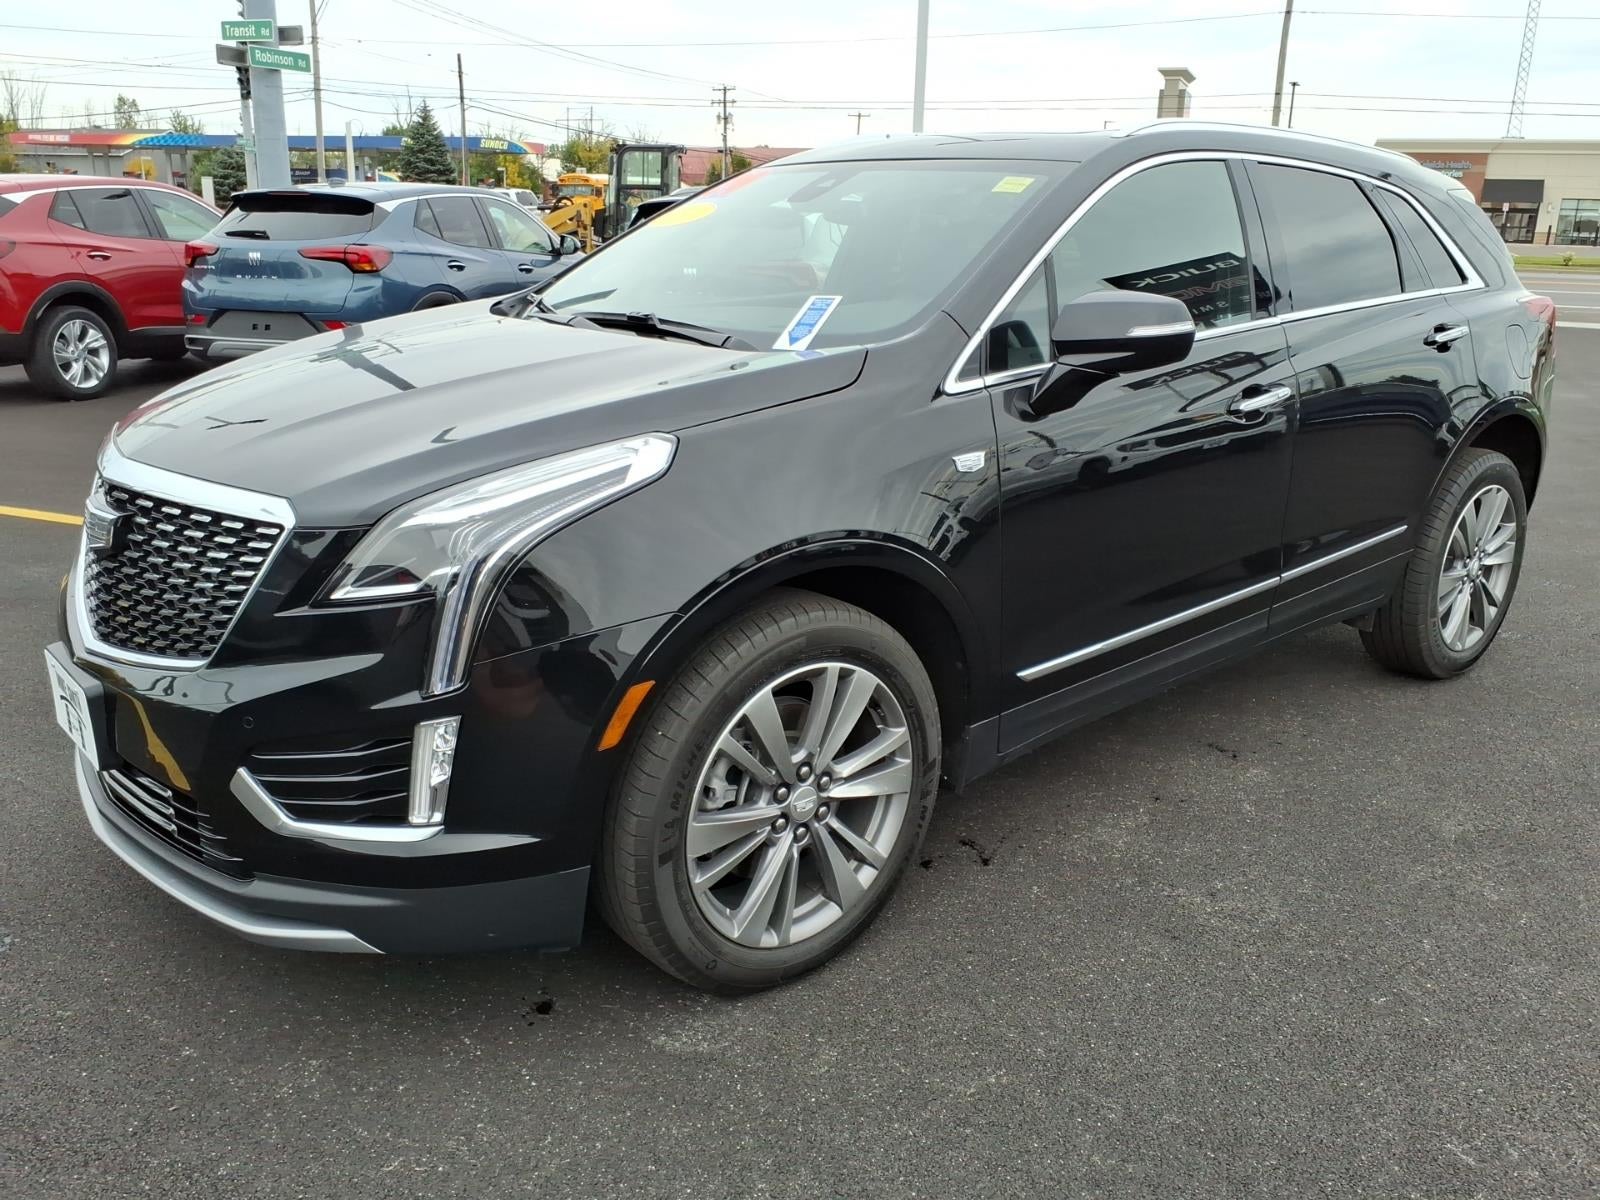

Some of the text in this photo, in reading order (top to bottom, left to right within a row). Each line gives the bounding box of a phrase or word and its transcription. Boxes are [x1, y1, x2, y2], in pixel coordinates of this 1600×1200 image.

[224, 25, 270, 37] Transit Rd
[255, 49, 307, 68] Robinson Rd
[480, 139, 508, 150] SUNOCO
